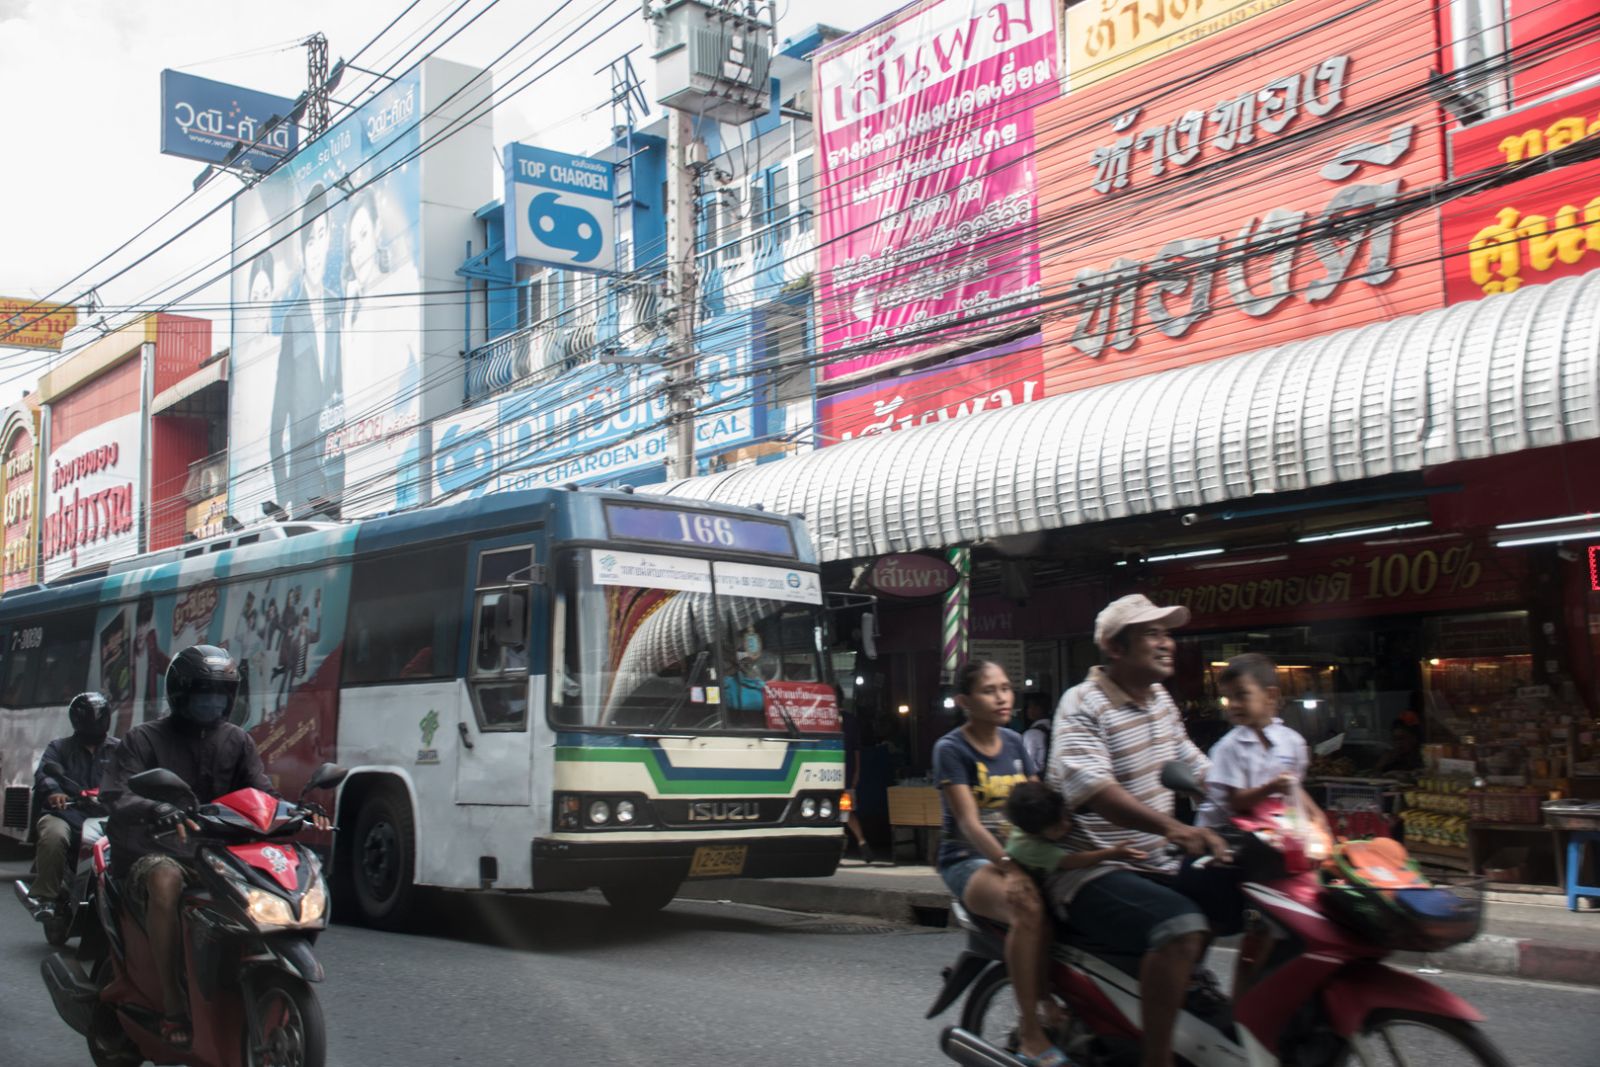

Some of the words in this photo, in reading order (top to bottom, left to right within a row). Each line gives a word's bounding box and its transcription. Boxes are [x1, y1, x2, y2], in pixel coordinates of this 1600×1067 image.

[1089, 54, 1352, 194] ห้างทอง
[518, 159, 546, 178] TOP
[550, 165, 608, 192] CHAROEN
[544, 441, 640, 484] CHAROEN
[678, 512, 736, 546] 166
[1364, 542, 1483, 600] 100%
[687, 802, 760, 821] ISUZU
